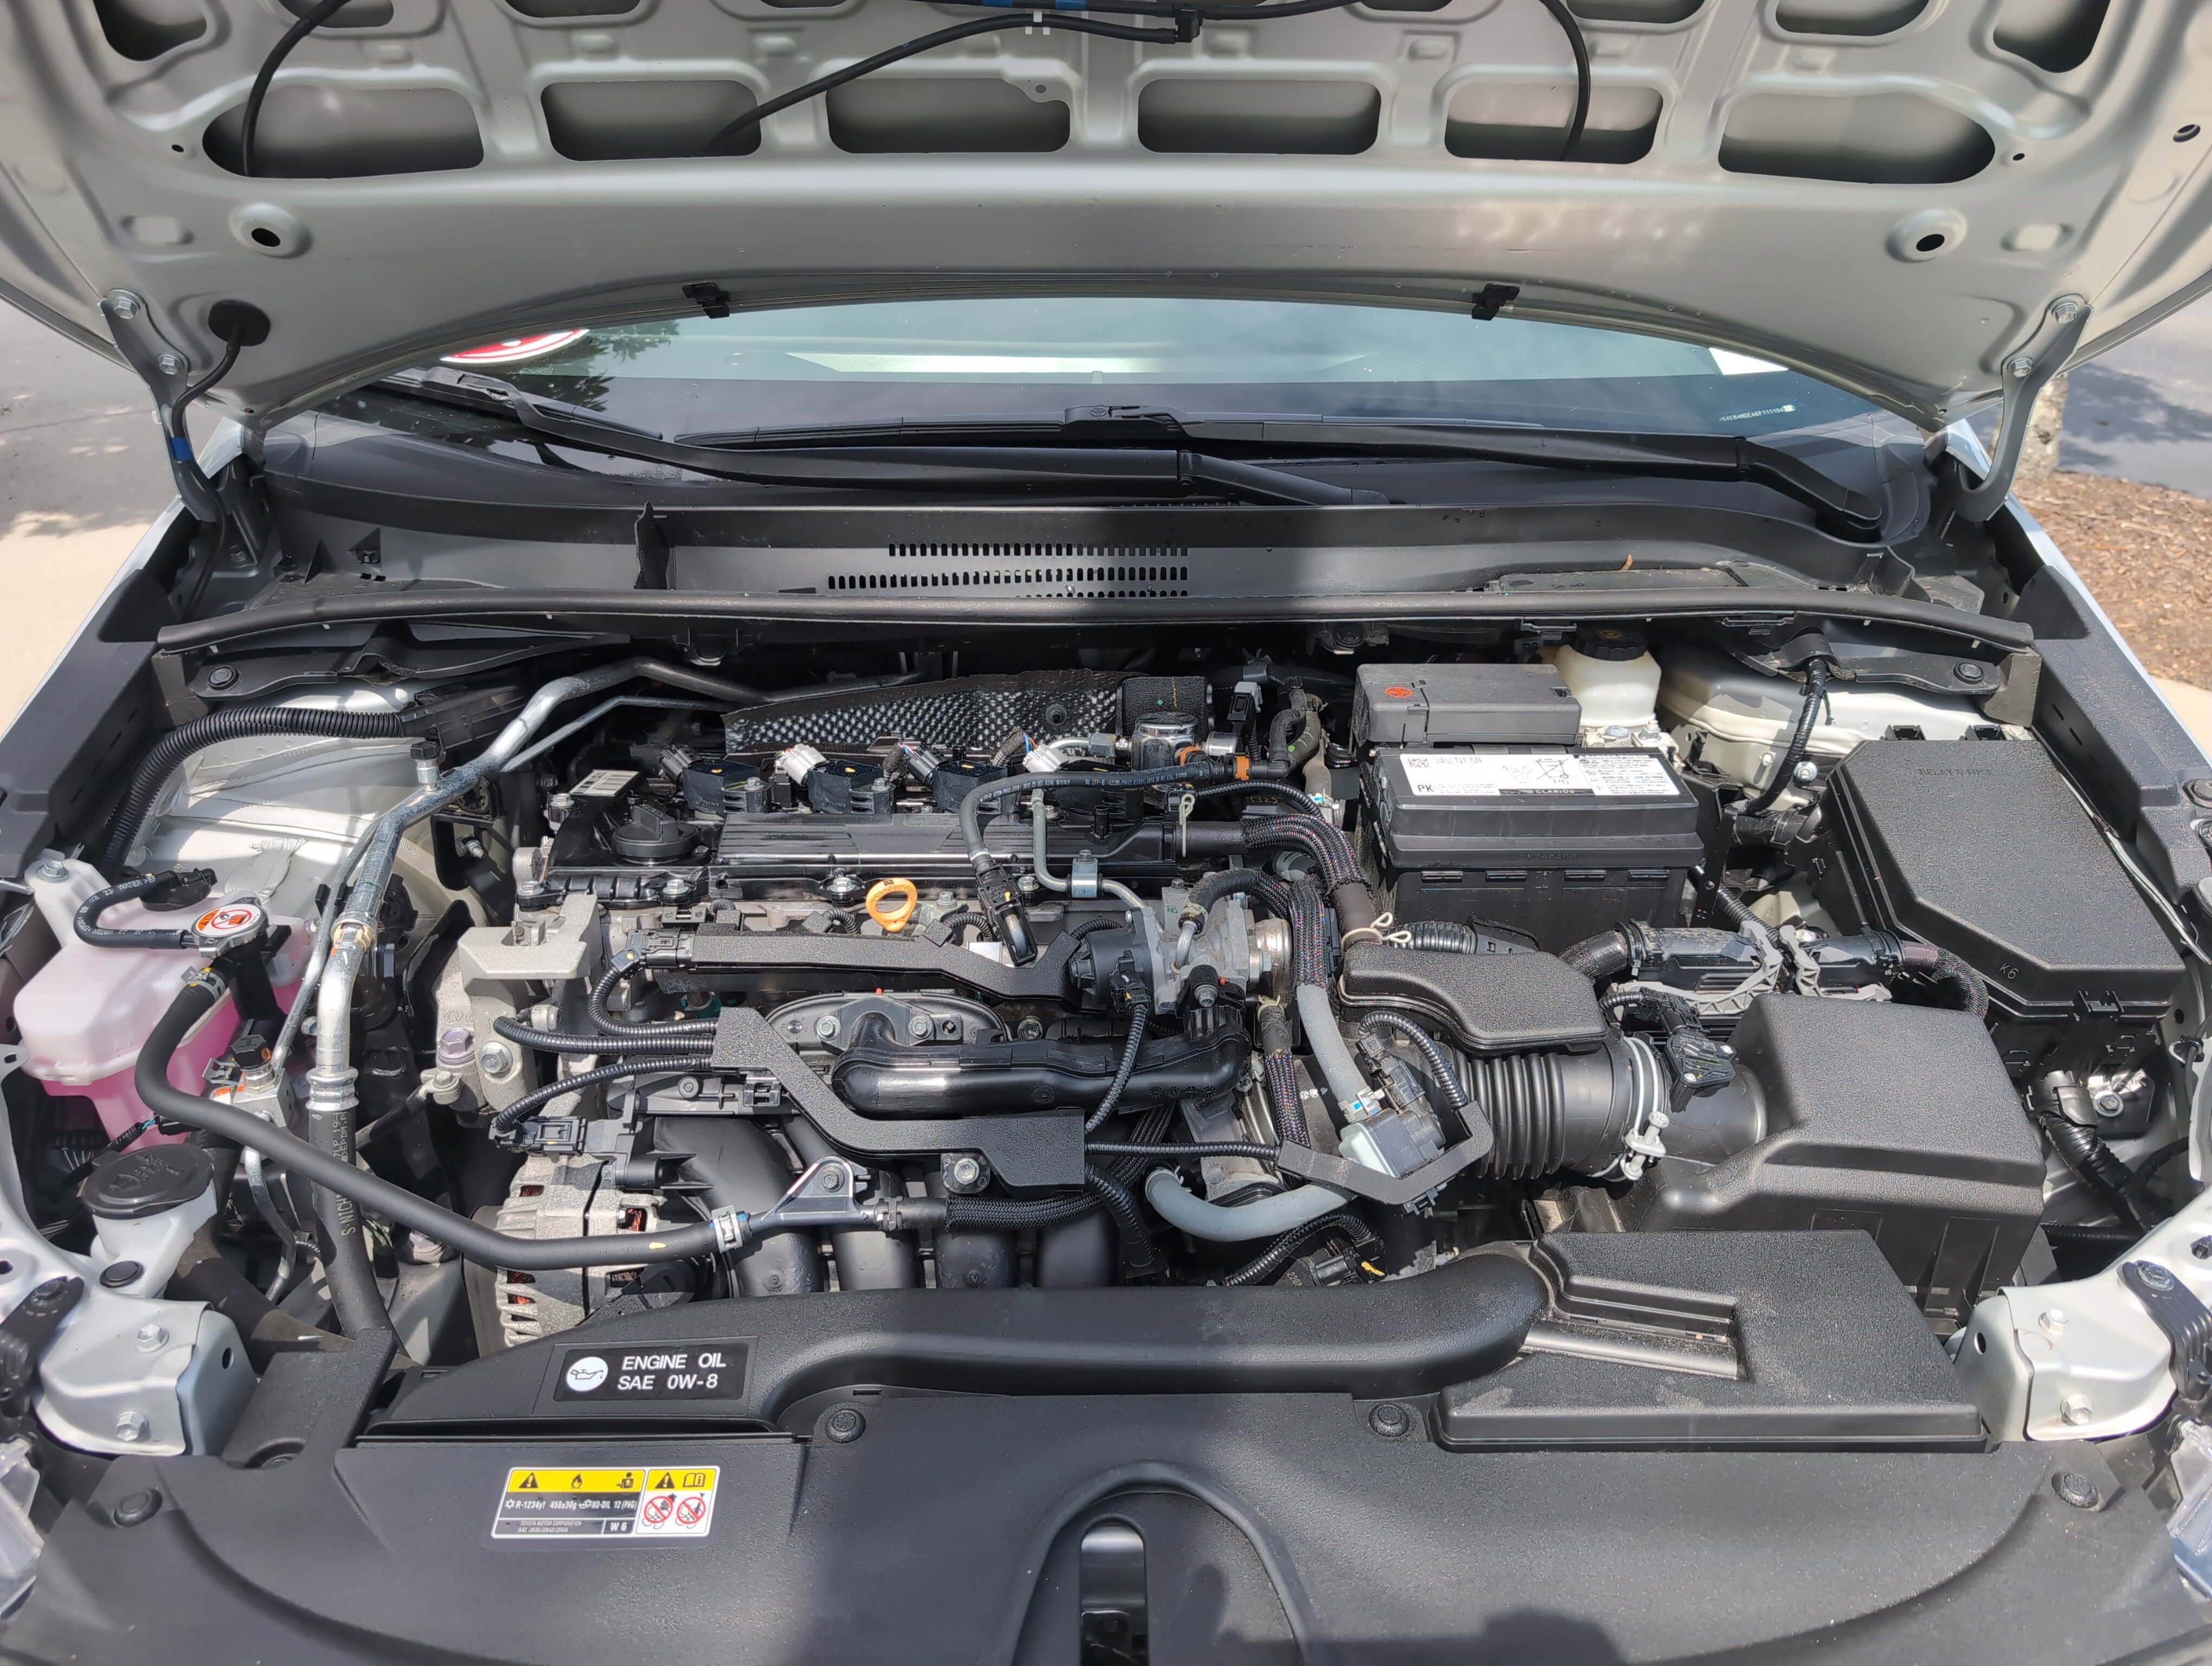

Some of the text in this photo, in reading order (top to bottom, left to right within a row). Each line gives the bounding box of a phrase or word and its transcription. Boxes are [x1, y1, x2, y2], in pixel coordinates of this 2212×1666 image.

[1417, 784, 1435, 793] PK
[117, 879, 143, 891] WATER
[1999, 962, 2019, 979] K6
[621, 1352, 726, 1370] ENGINE OIL
[617, 1373, 718, 1390] SAE 0W-8
[614, 1500, 621, 1509] 12
[621, 1500, 638, 1510] (PAG)
[610, 1522, 628, 1531] W 6
